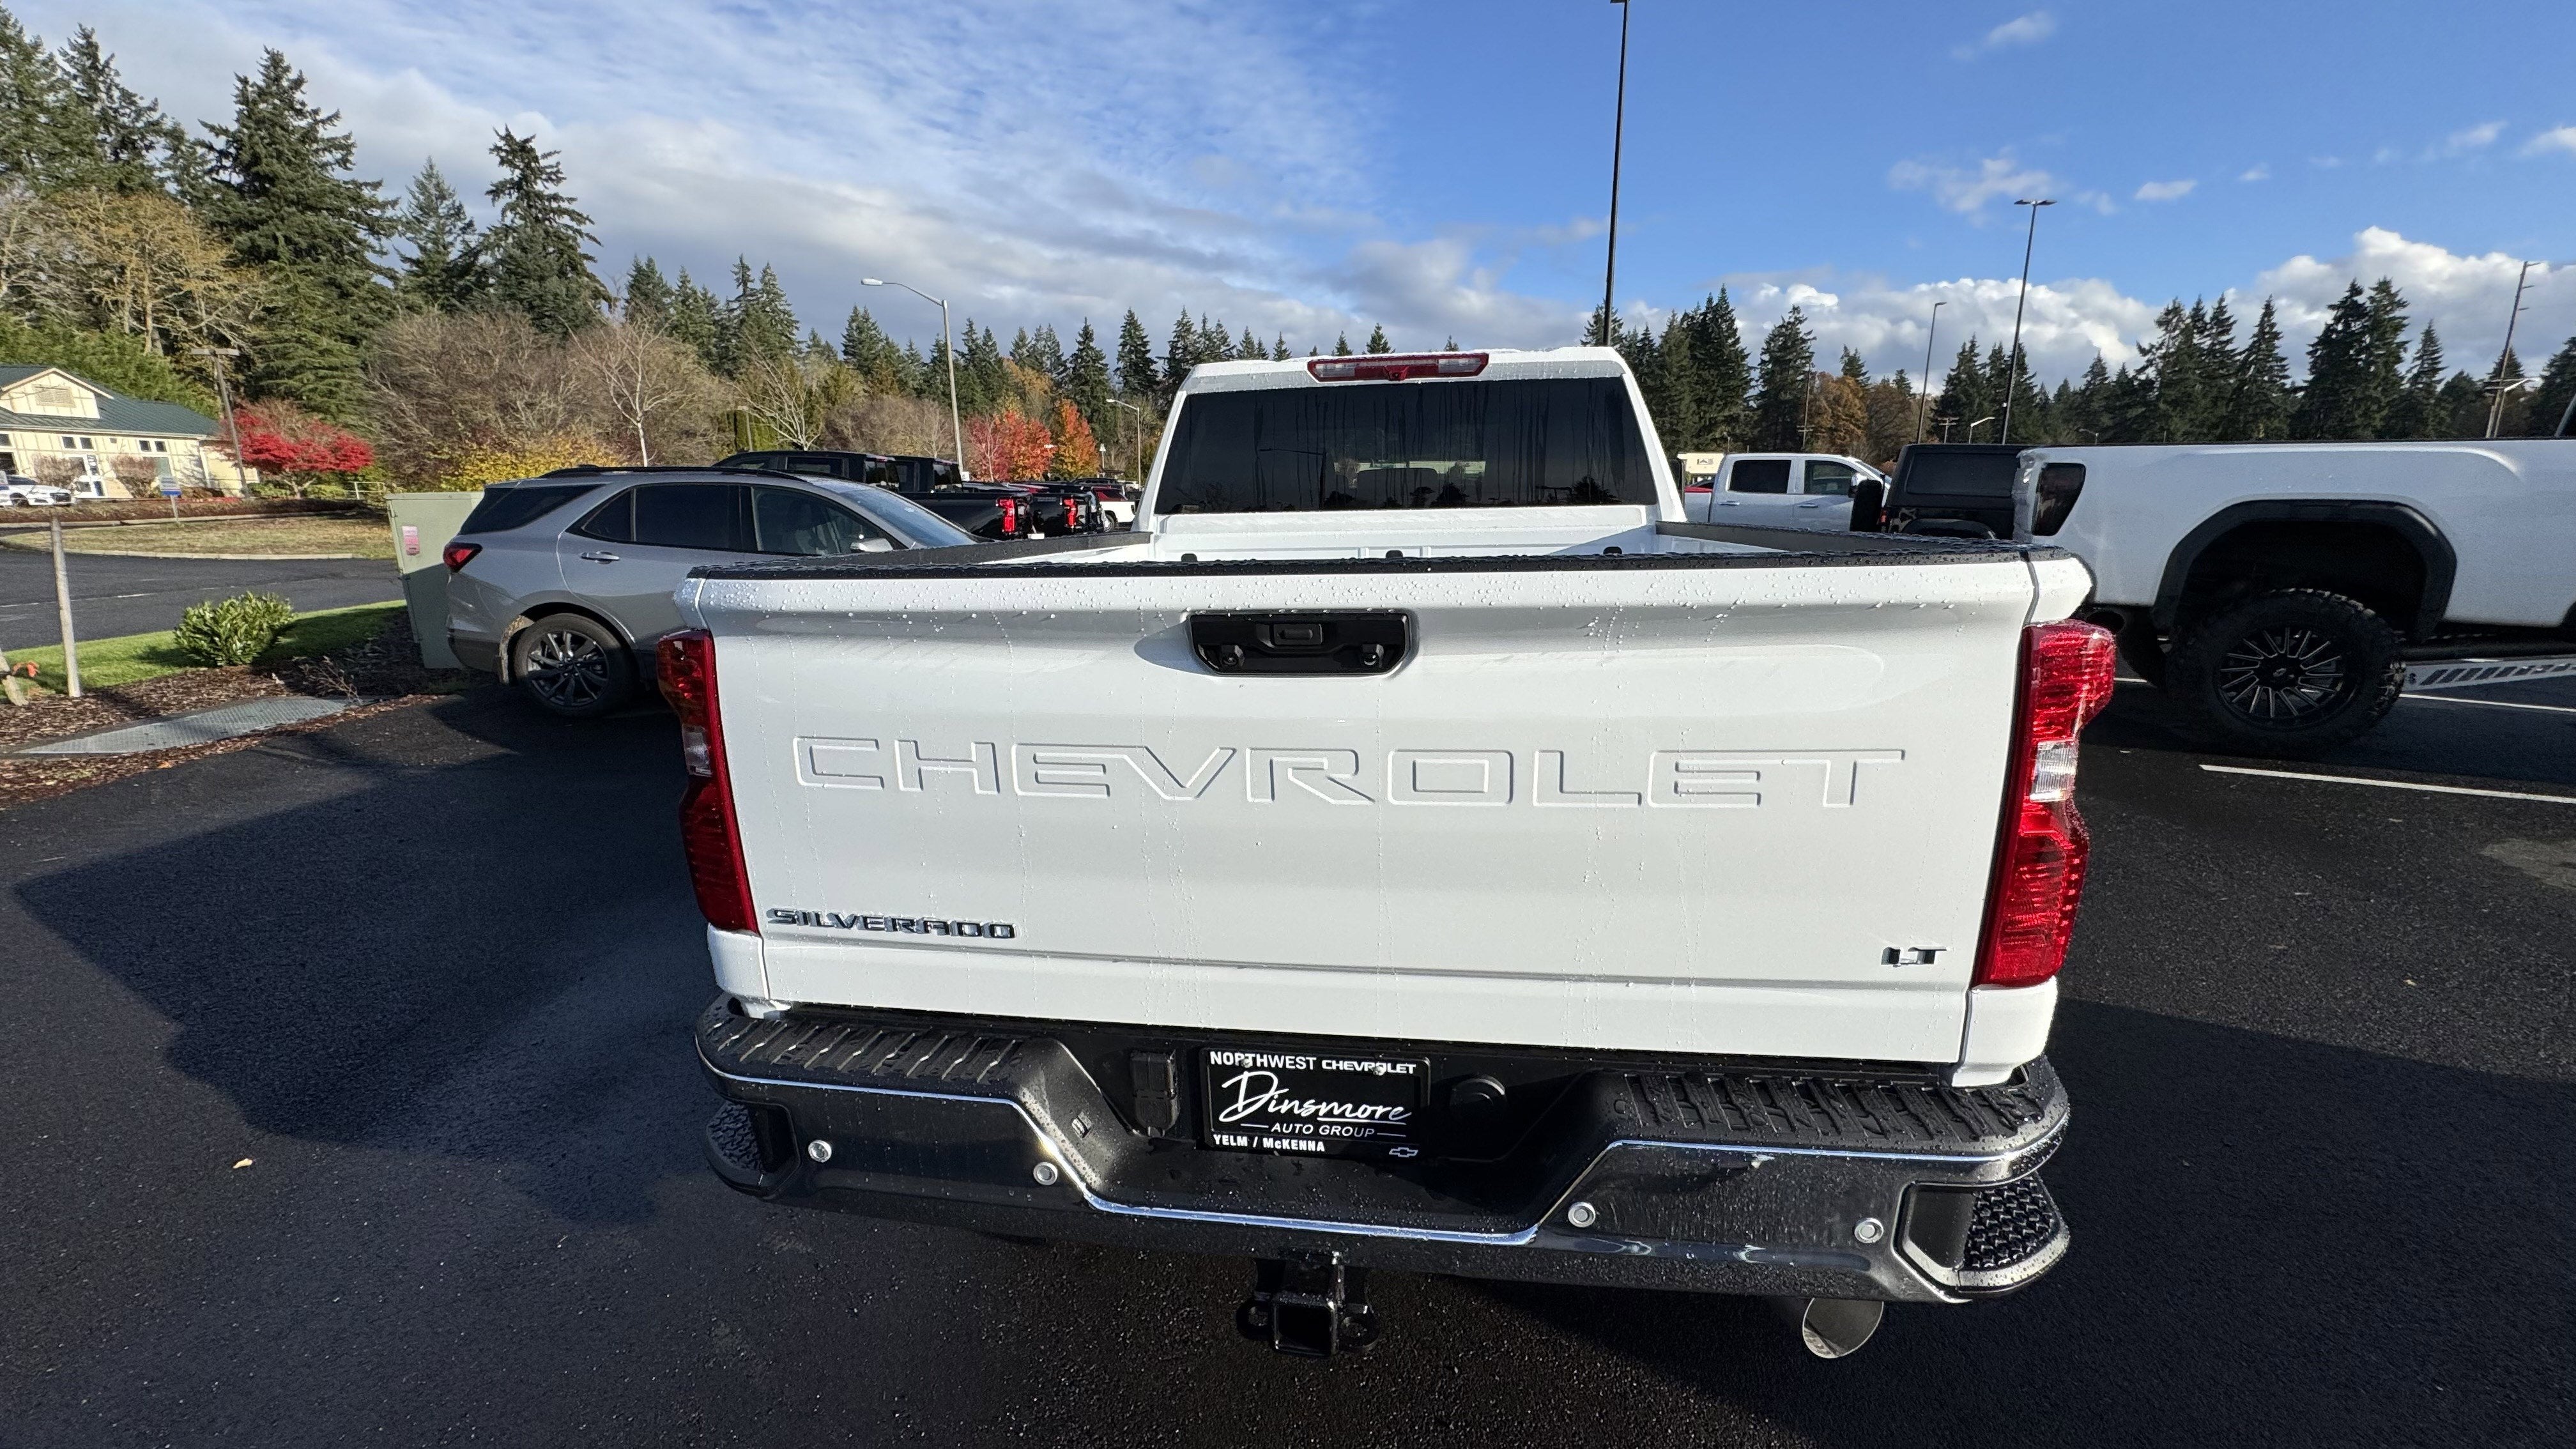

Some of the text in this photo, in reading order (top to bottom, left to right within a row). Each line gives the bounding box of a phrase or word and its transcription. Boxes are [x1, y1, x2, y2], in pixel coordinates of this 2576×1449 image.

[793, 737, 1906, 808] CHEVROLET
[767, 907, 1018, 939] SILVERADO
[1881, 947, 1947, 967] LT
[1210, 1051, 1416, 1075] NORTHWEST CHEVROLET
[1218, 1070, 1412, 1123] Dinsmore
[1271, 1123, 1375, 1137] AUTO GROUP
[1213, 1134, 1248, 1147] YELM
[1262, 1137, 1325, 1152] McKENNA
